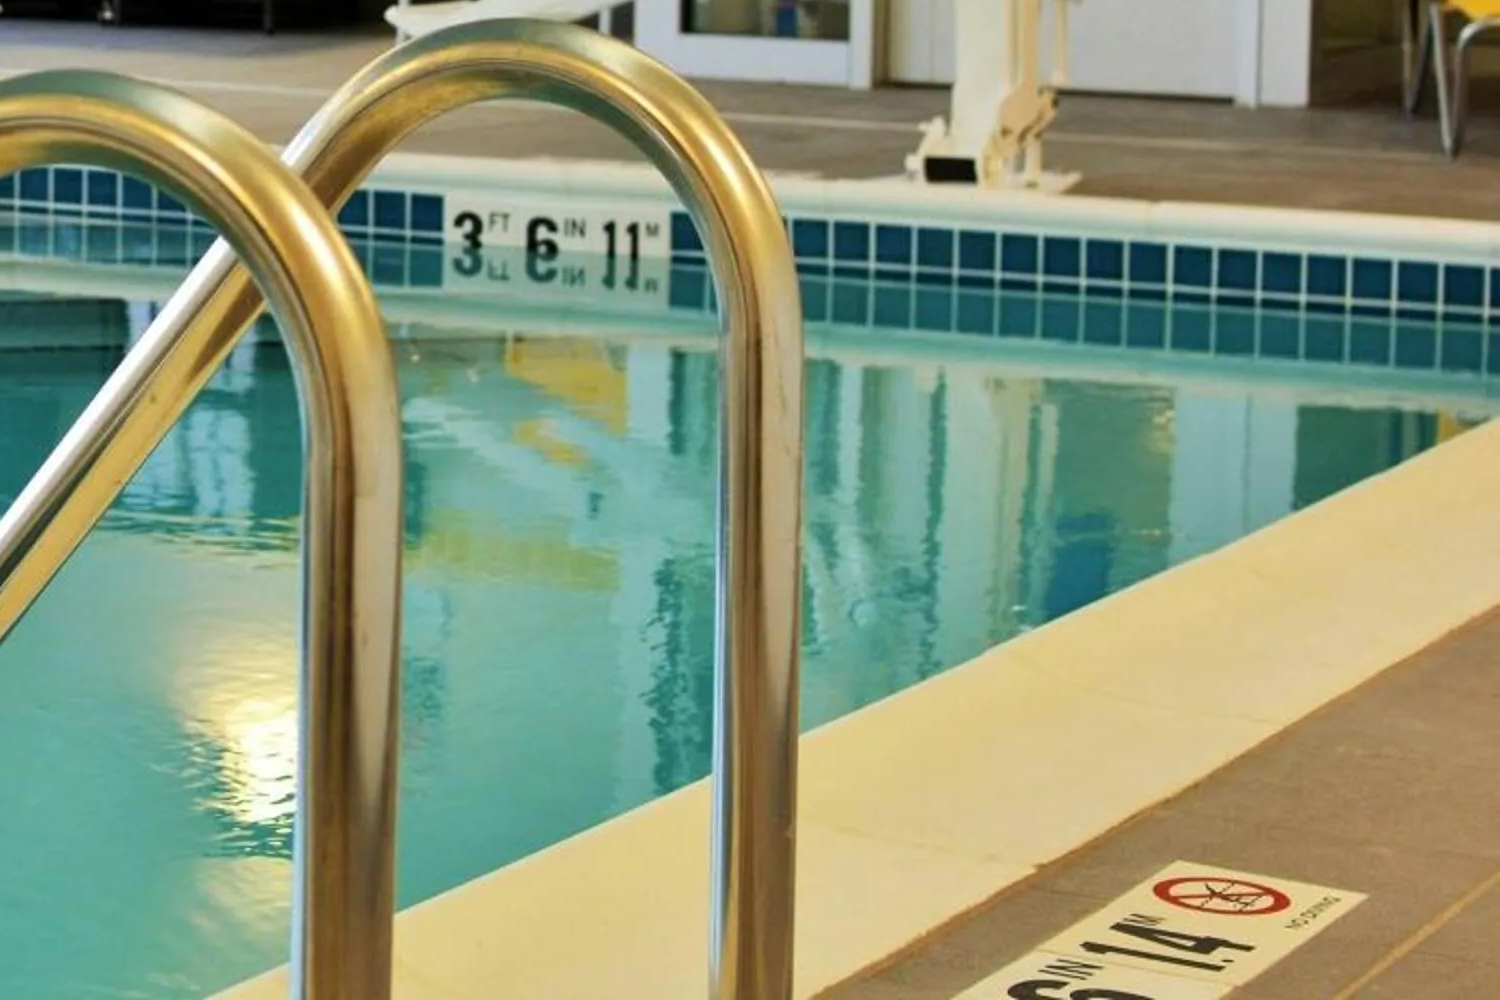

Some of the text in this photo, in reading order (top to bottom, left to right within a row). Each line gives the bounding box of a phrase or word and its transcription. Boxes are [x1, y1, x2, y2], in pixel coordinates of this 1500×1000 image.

[453, 211, 484, 250] 3
[488, 212, 511, 232] FT
[526, 216, 559, 260] 6
[564, 217, 587, 238] IN
[1038, 958, 1105, 980] IN
[1079, 922, 1256, 972] 1.4
